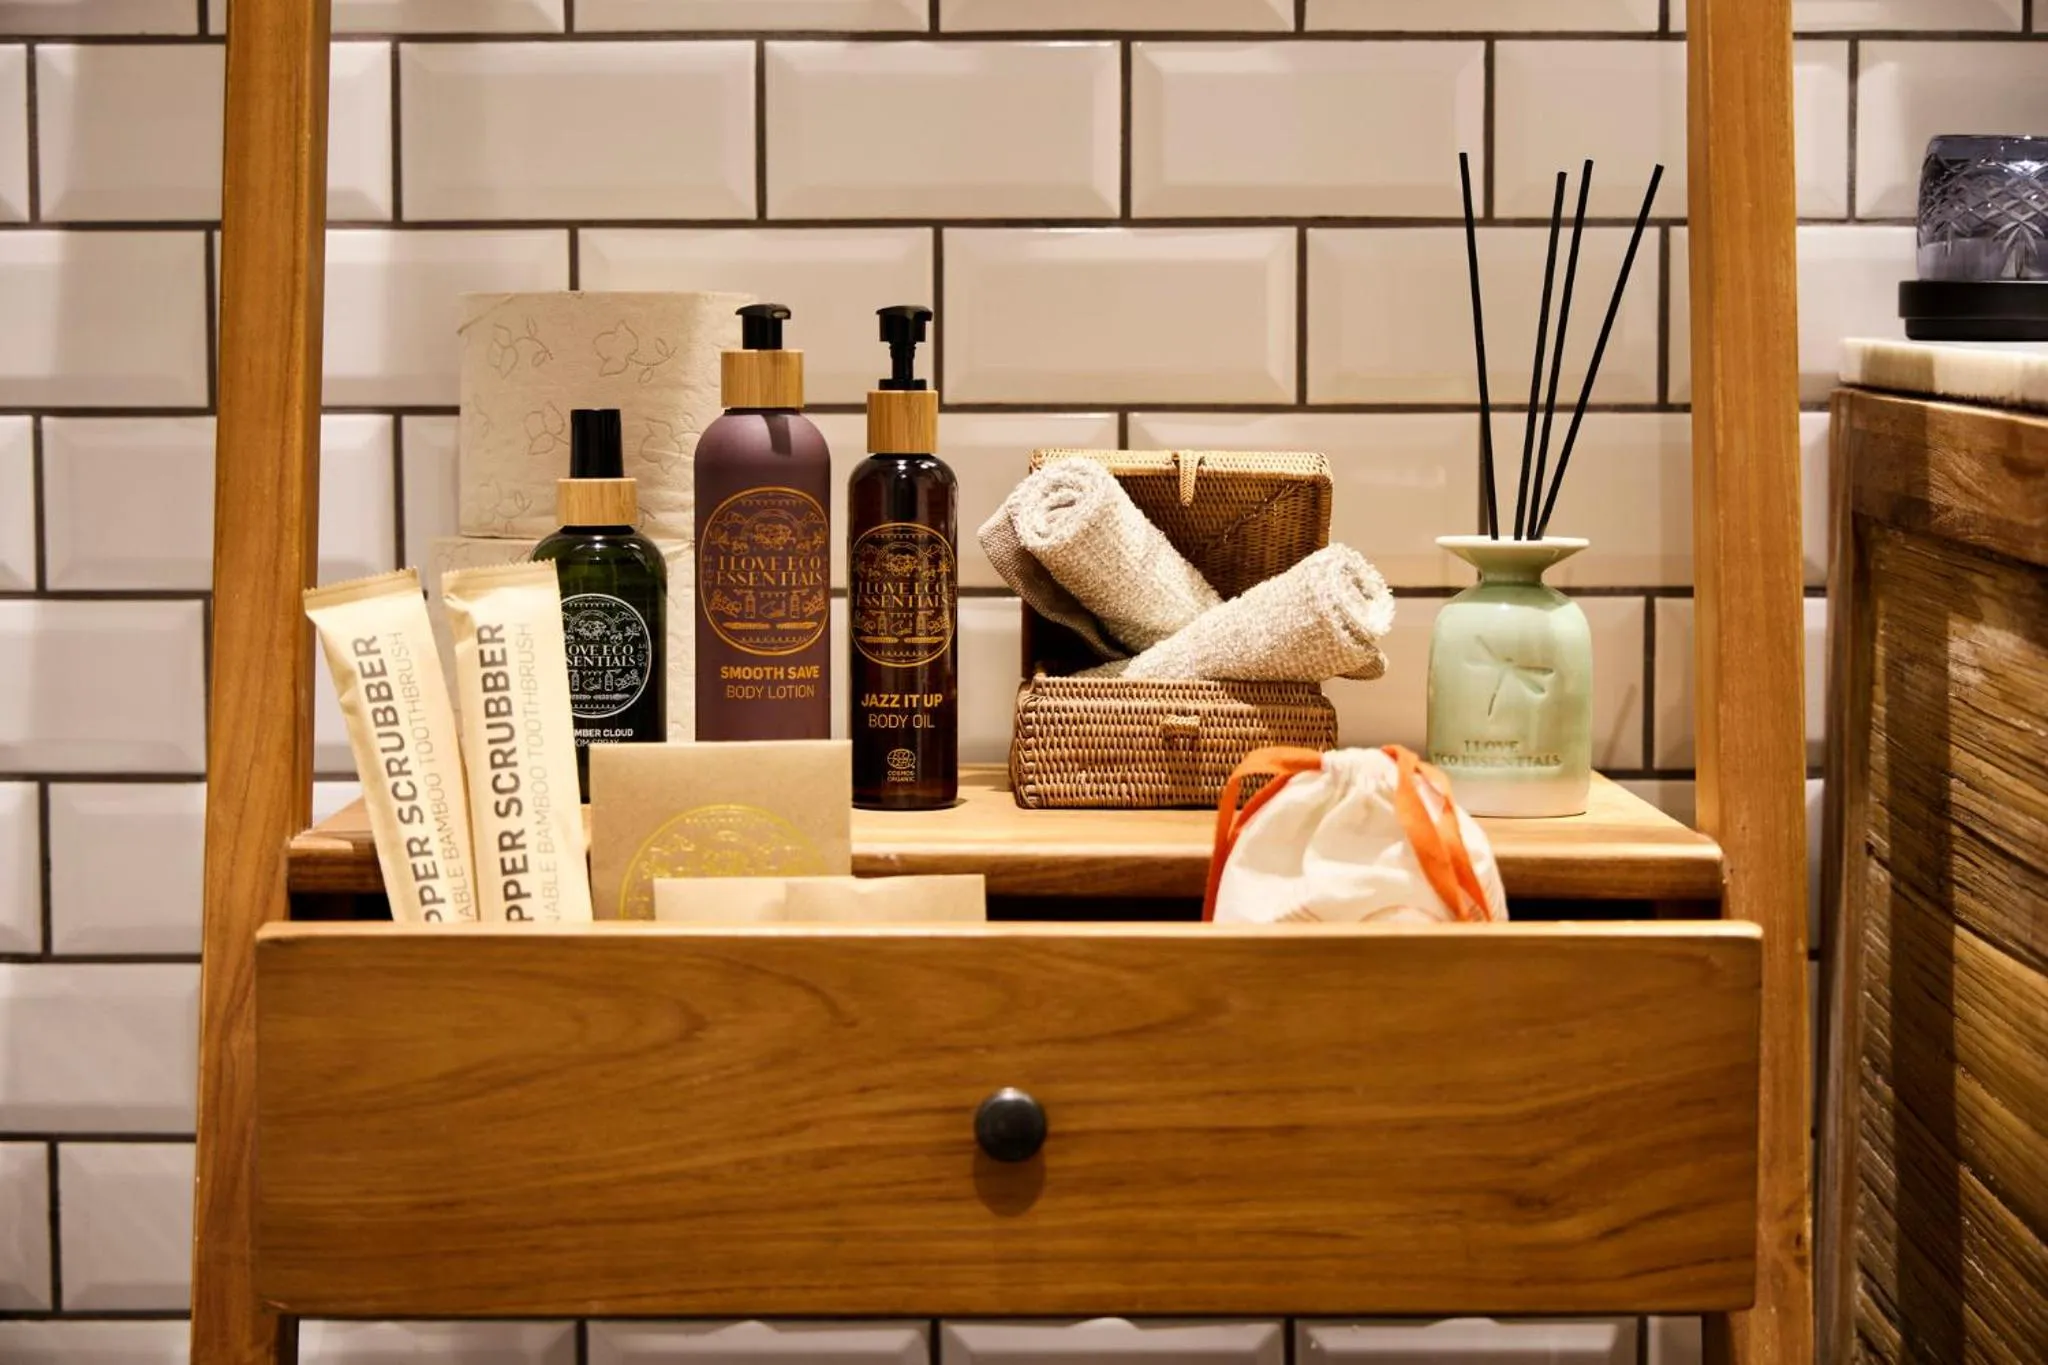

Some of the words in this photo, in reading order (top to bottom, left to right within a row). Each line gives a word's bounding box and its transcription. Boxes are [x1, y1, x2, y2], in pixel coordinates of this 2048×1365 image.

[514, 623, 544, 760] TOOTHBRUSH
[566, 656, 636, 667] SENTIALS
[568, 644, 599, 656] OVE
[602, 644, 634, 656] ECO
[720, 666, 785, 680] SMOOTH
[788, 665, 820, 679] SAVE
[727, 685, 764, 699] BODY
[768, 684, 815, 698] LOTION
[352, 635, 425, 825] SCRUBBER
[387, 631, 437, 768] TOOTHBRUSH
[477, 623, 523, 818] SCRUBBER
[574, 728, 601, 737] MBER
[603, 728, 634, 737] CLOUD
[861, 693, 900, 708] JAZZ
[904, 694, 920, 708] IT
[923, 693, 943, 708] UP
[868, 713, 908, 728] BODY
[912, 714, 935, 728] OIL
[425, 773, 460, 860] BAMBOO
[531, 766, 556, 853] BAMBOO
[406, 836, 446, 922] PPER
[498, 828, 534, 922] PPER
